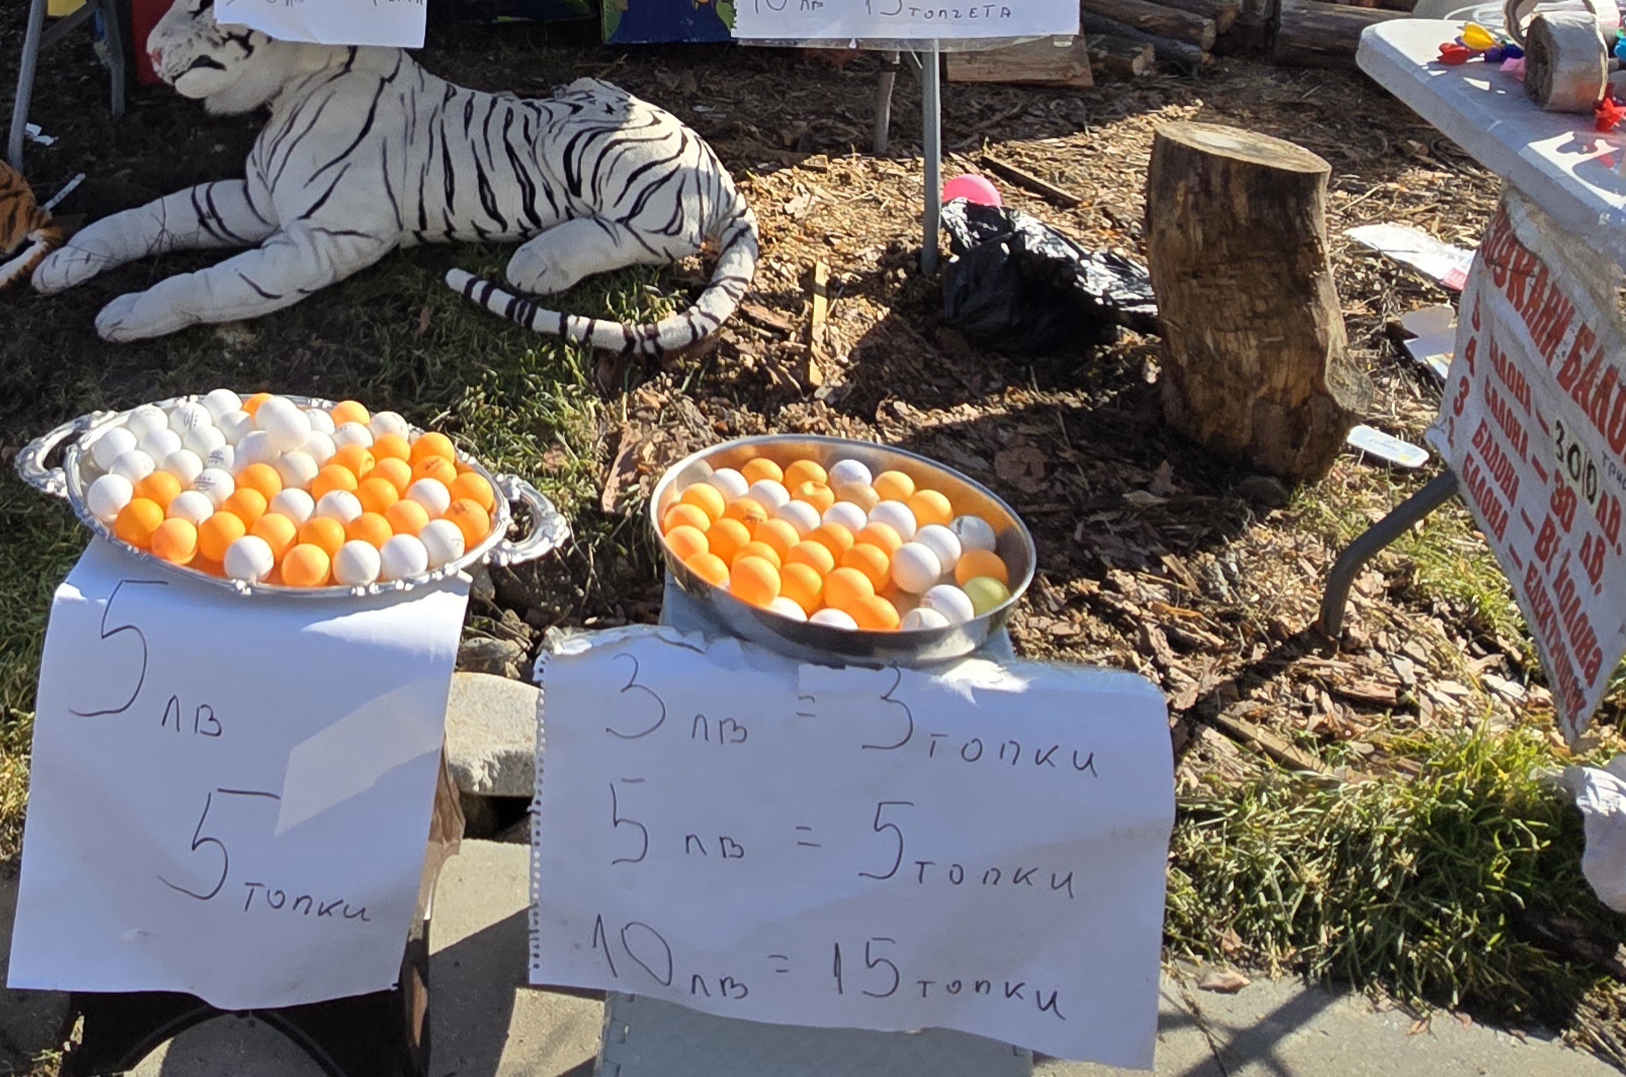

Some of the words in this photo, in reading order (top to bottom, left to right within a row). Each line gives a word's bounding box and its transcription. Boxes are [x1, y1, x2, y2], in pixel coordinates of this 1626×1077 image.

[1453, 376, 1470, 417] 3
[1471, 417, 1520, 508] БАЛОНА
[1556, 321, 1626, 469] БАЛО
